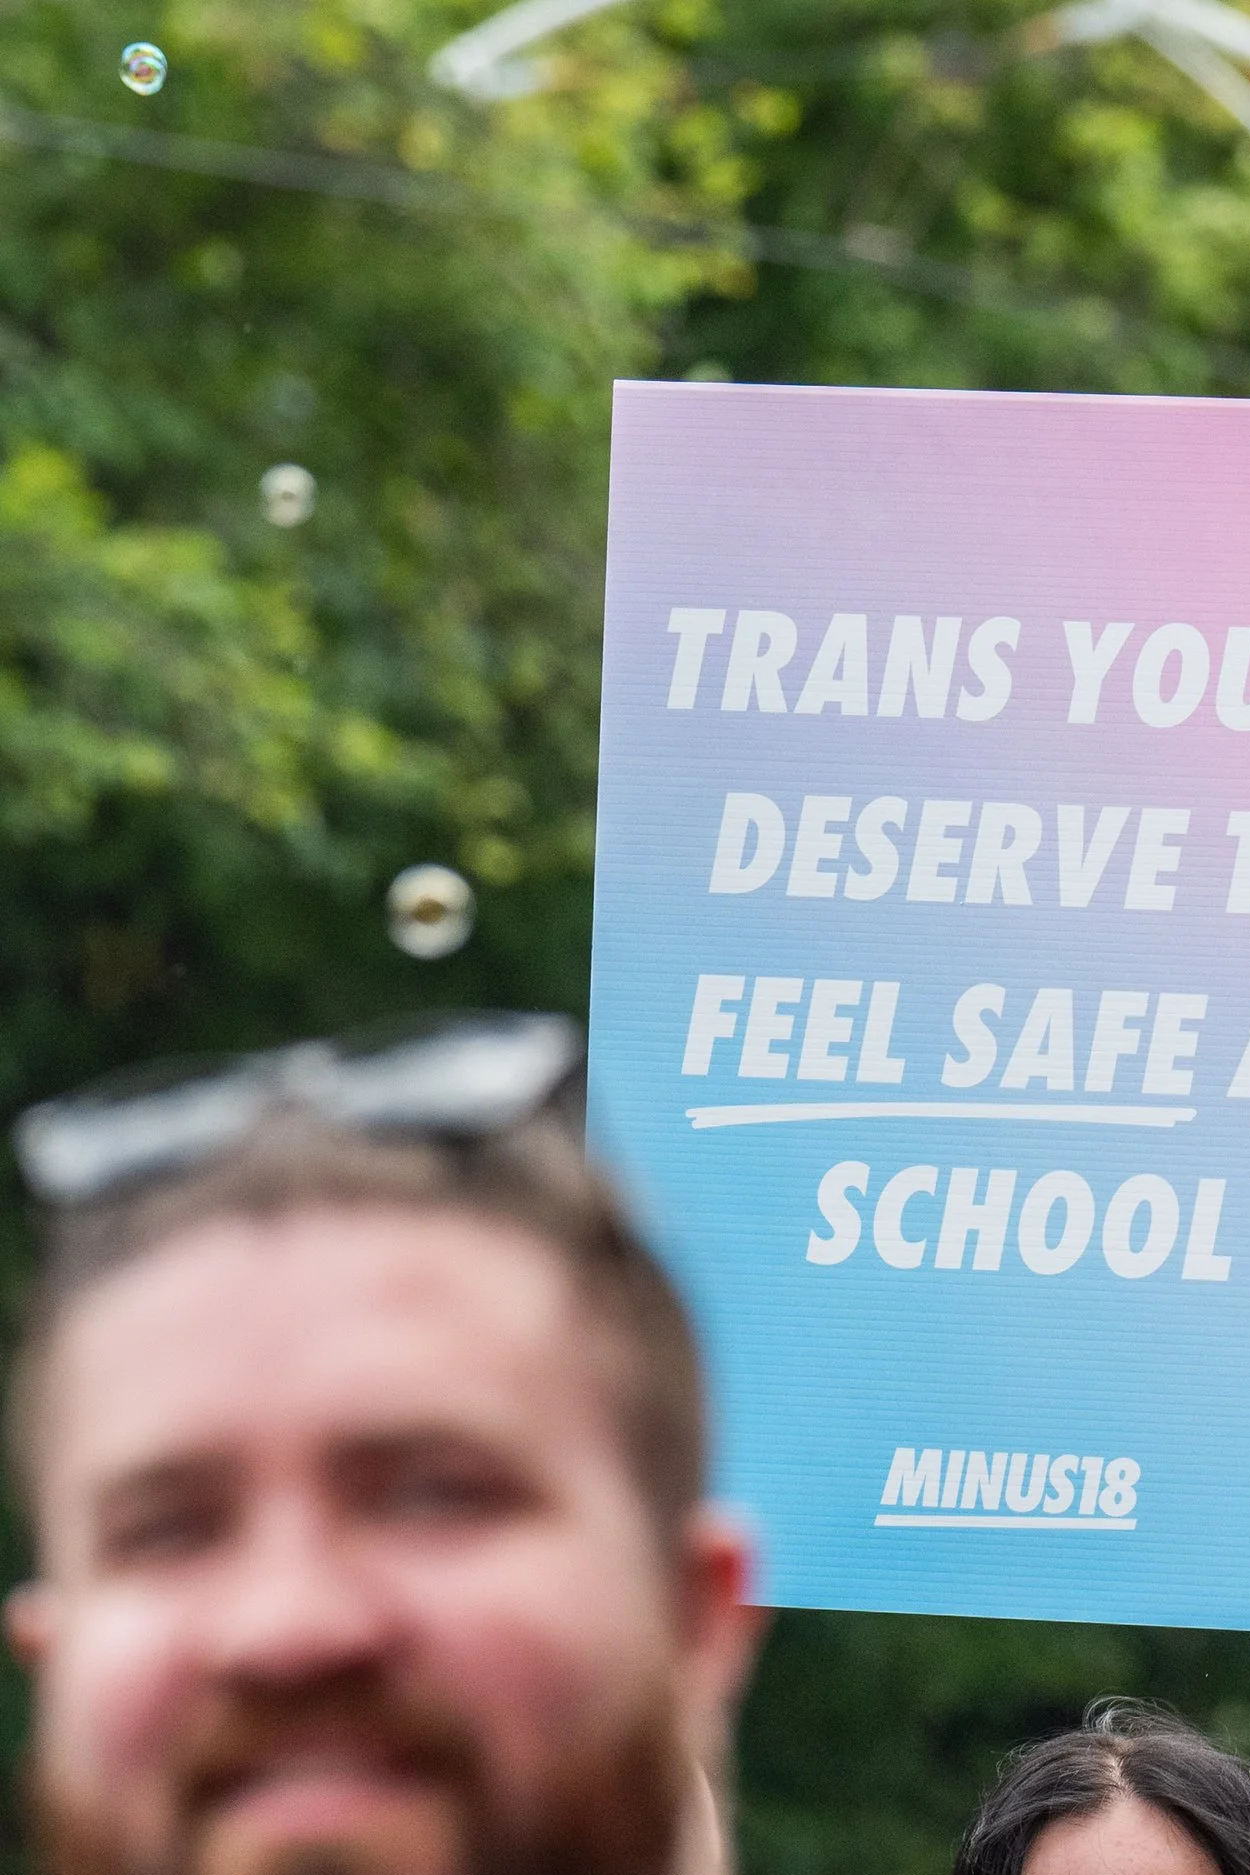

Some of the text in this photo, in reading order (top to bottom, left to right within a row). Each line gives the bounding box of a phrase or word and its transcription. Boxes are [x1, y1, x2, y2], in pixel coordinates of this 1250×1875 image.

[665, 607, 1022, 720] TRANS
[708, 792, 1193, 913] DESERVE
[680, 973, 906, 1083] FEEL
[940, 984, 1209, 1095] SAFE
[805, 1160, 1233, 1282] SCHOOL
[879, 1446, 1142, 1518] MINUS18
